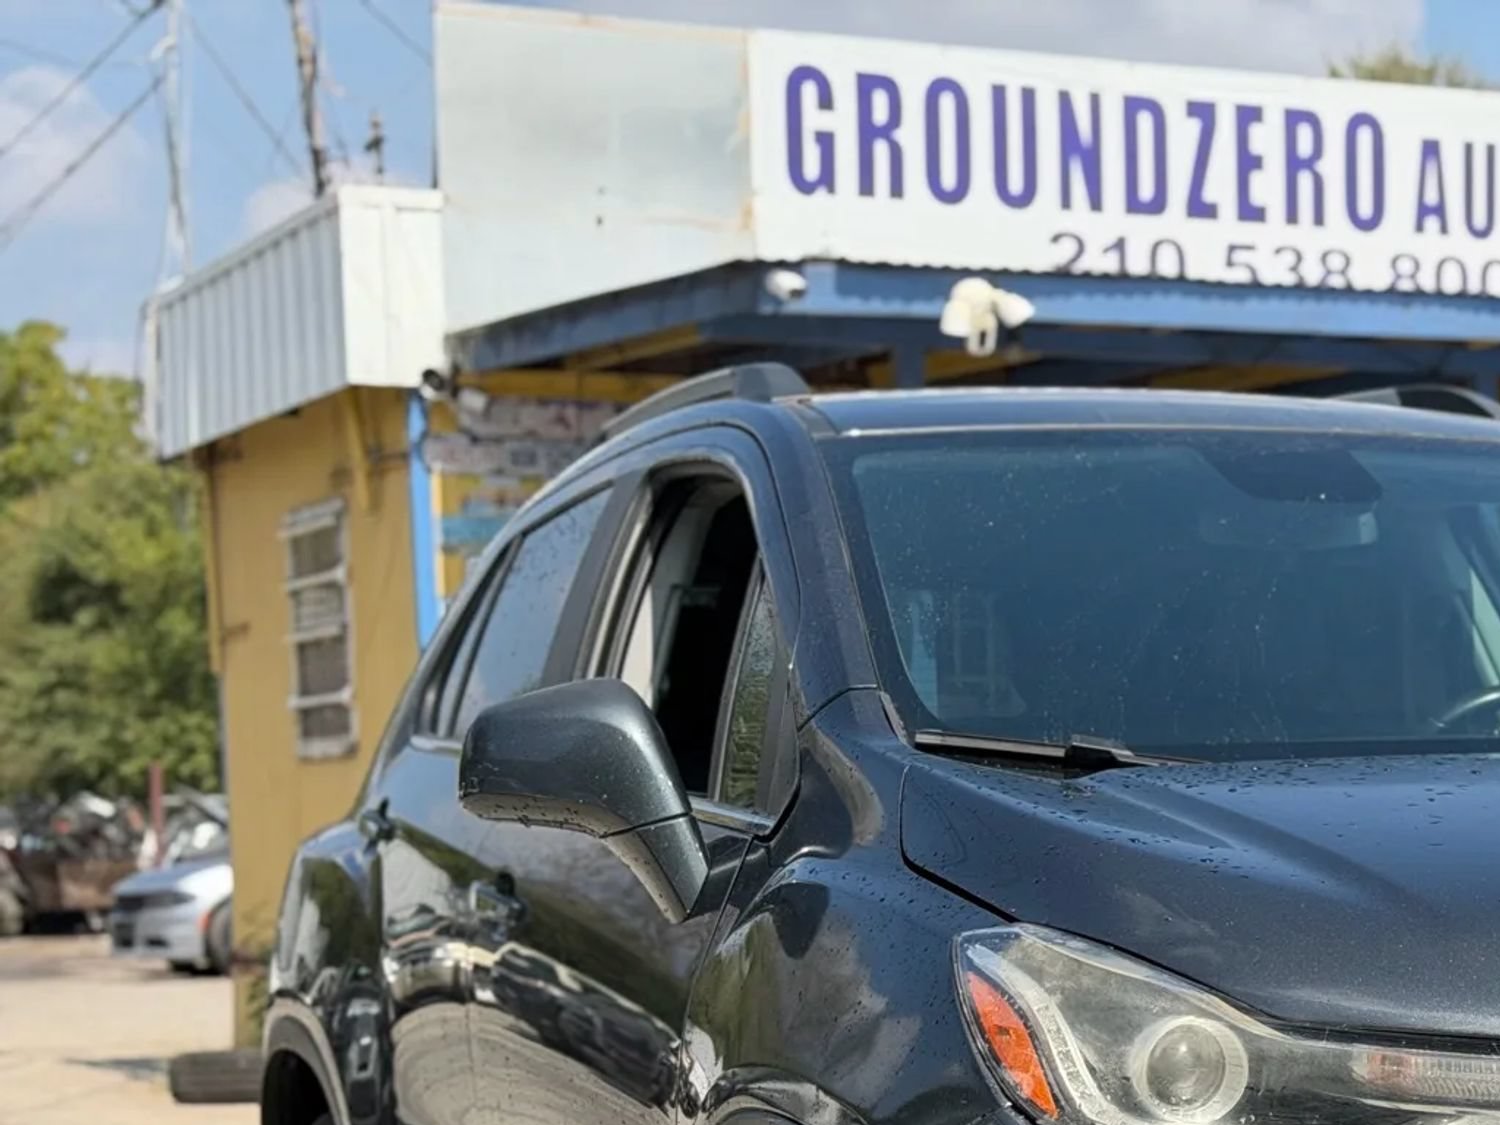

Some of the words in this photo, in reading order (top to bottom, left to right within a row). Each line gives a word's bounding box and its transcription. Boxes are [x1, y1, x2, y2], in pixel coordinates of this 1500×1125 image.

[785, 65, 1386, 233] GROUNDZERO
[1050, 232, 1186, 278] 210
[1225, 244, 1354, 291] 538
